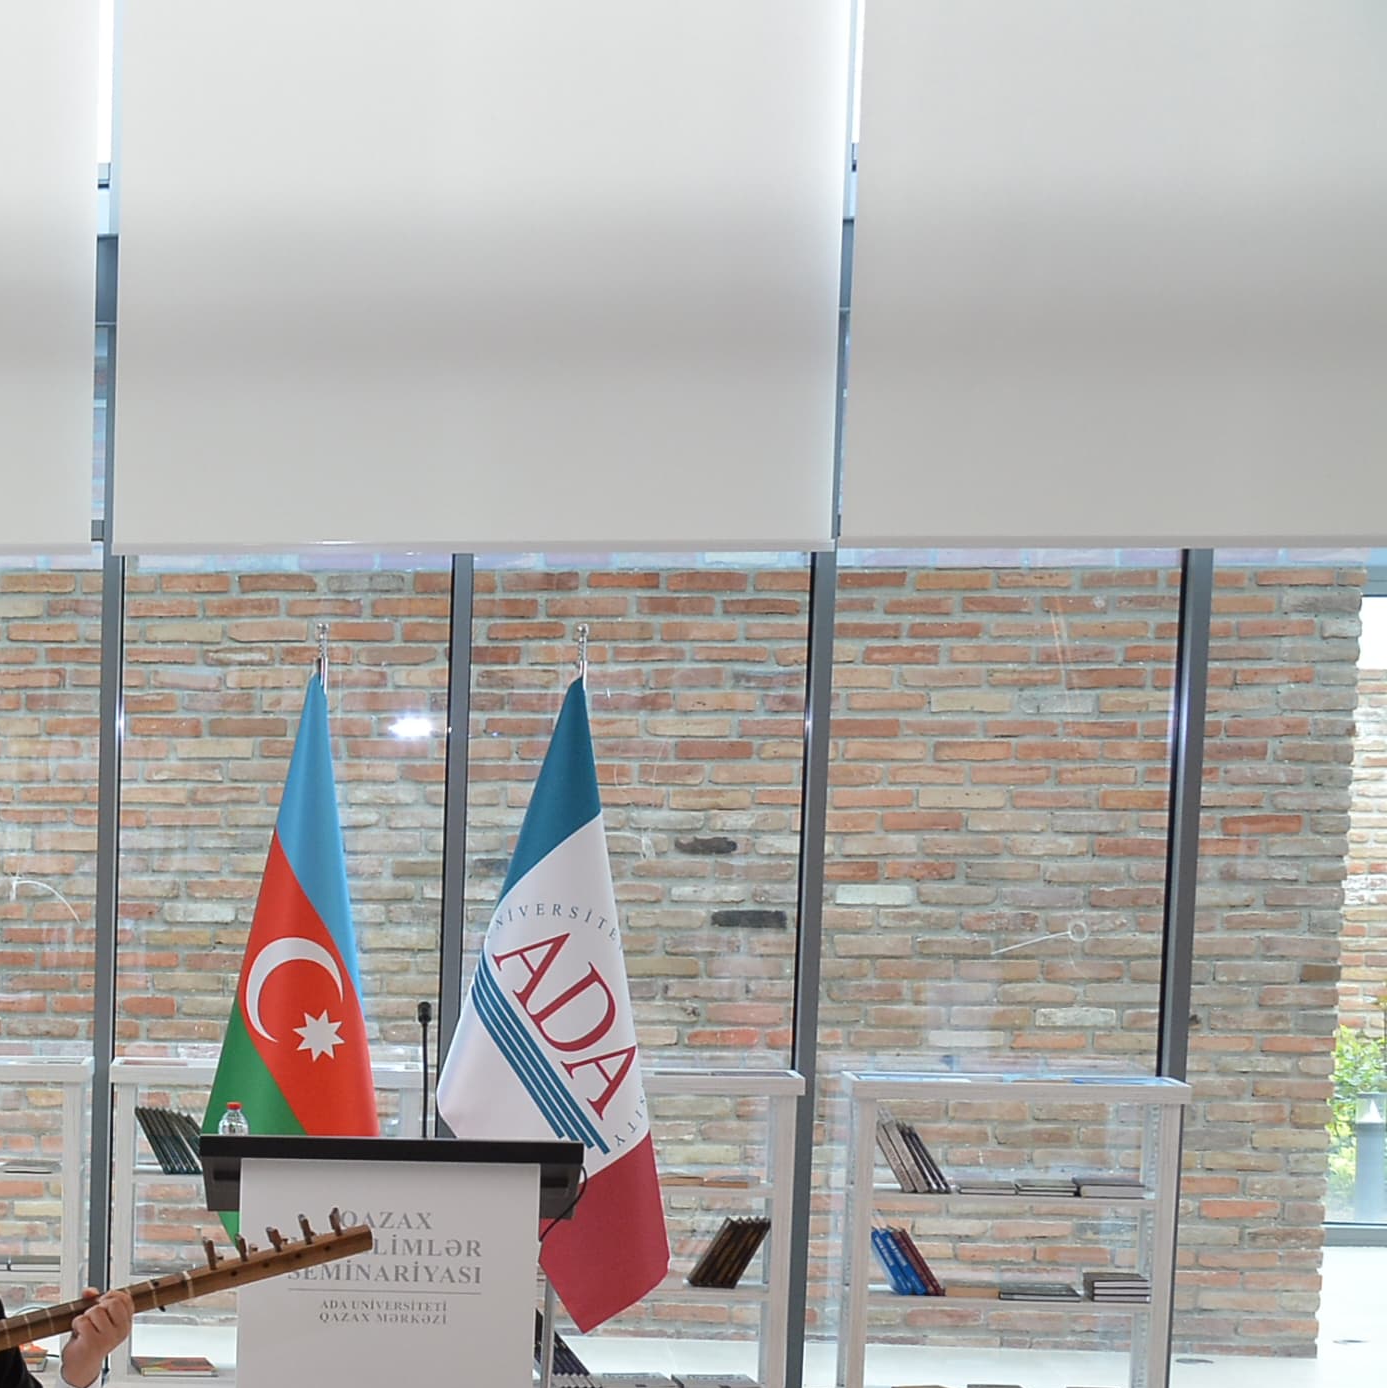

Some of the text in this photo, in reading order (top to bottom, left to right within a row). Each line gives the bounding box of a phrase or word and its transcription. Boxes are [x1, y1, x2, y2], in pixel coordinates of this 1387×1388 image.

[492, 932, 637, 1121] ADA
[321, 1299, 347, 1310] ADA
[319, 1312, 370, 1323] QAZAX
